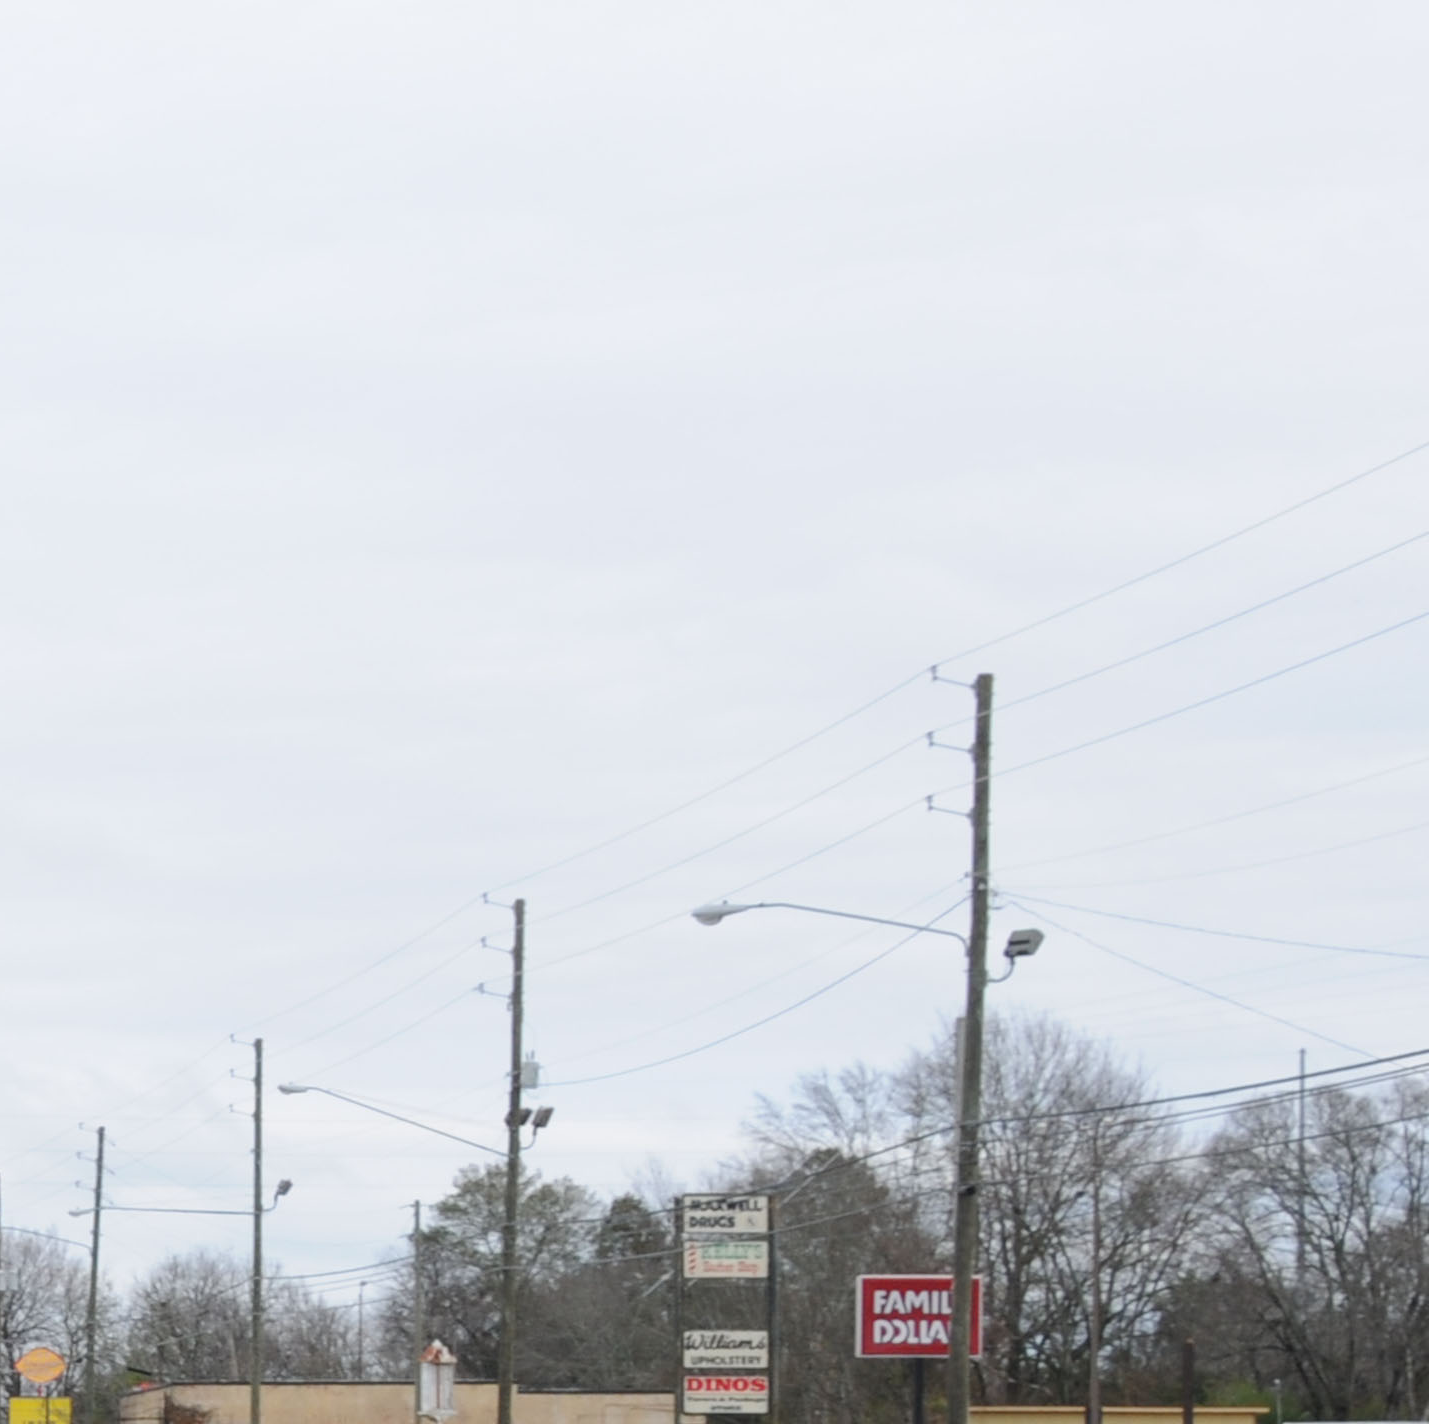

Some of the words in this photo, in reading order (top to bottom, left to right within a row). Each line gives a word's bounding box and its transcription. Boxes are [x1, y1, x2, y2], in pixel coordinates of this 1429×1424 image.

[689, 1215, 736, 1229] DRUGS
[873, 1289, 953, 1315] FAMIL
[873, 1318, 949, 1344] DOLLA
[690, 1355, 762, 1366] UPHOLSTERY
[686, 1378, 767, 1392] DINOS
